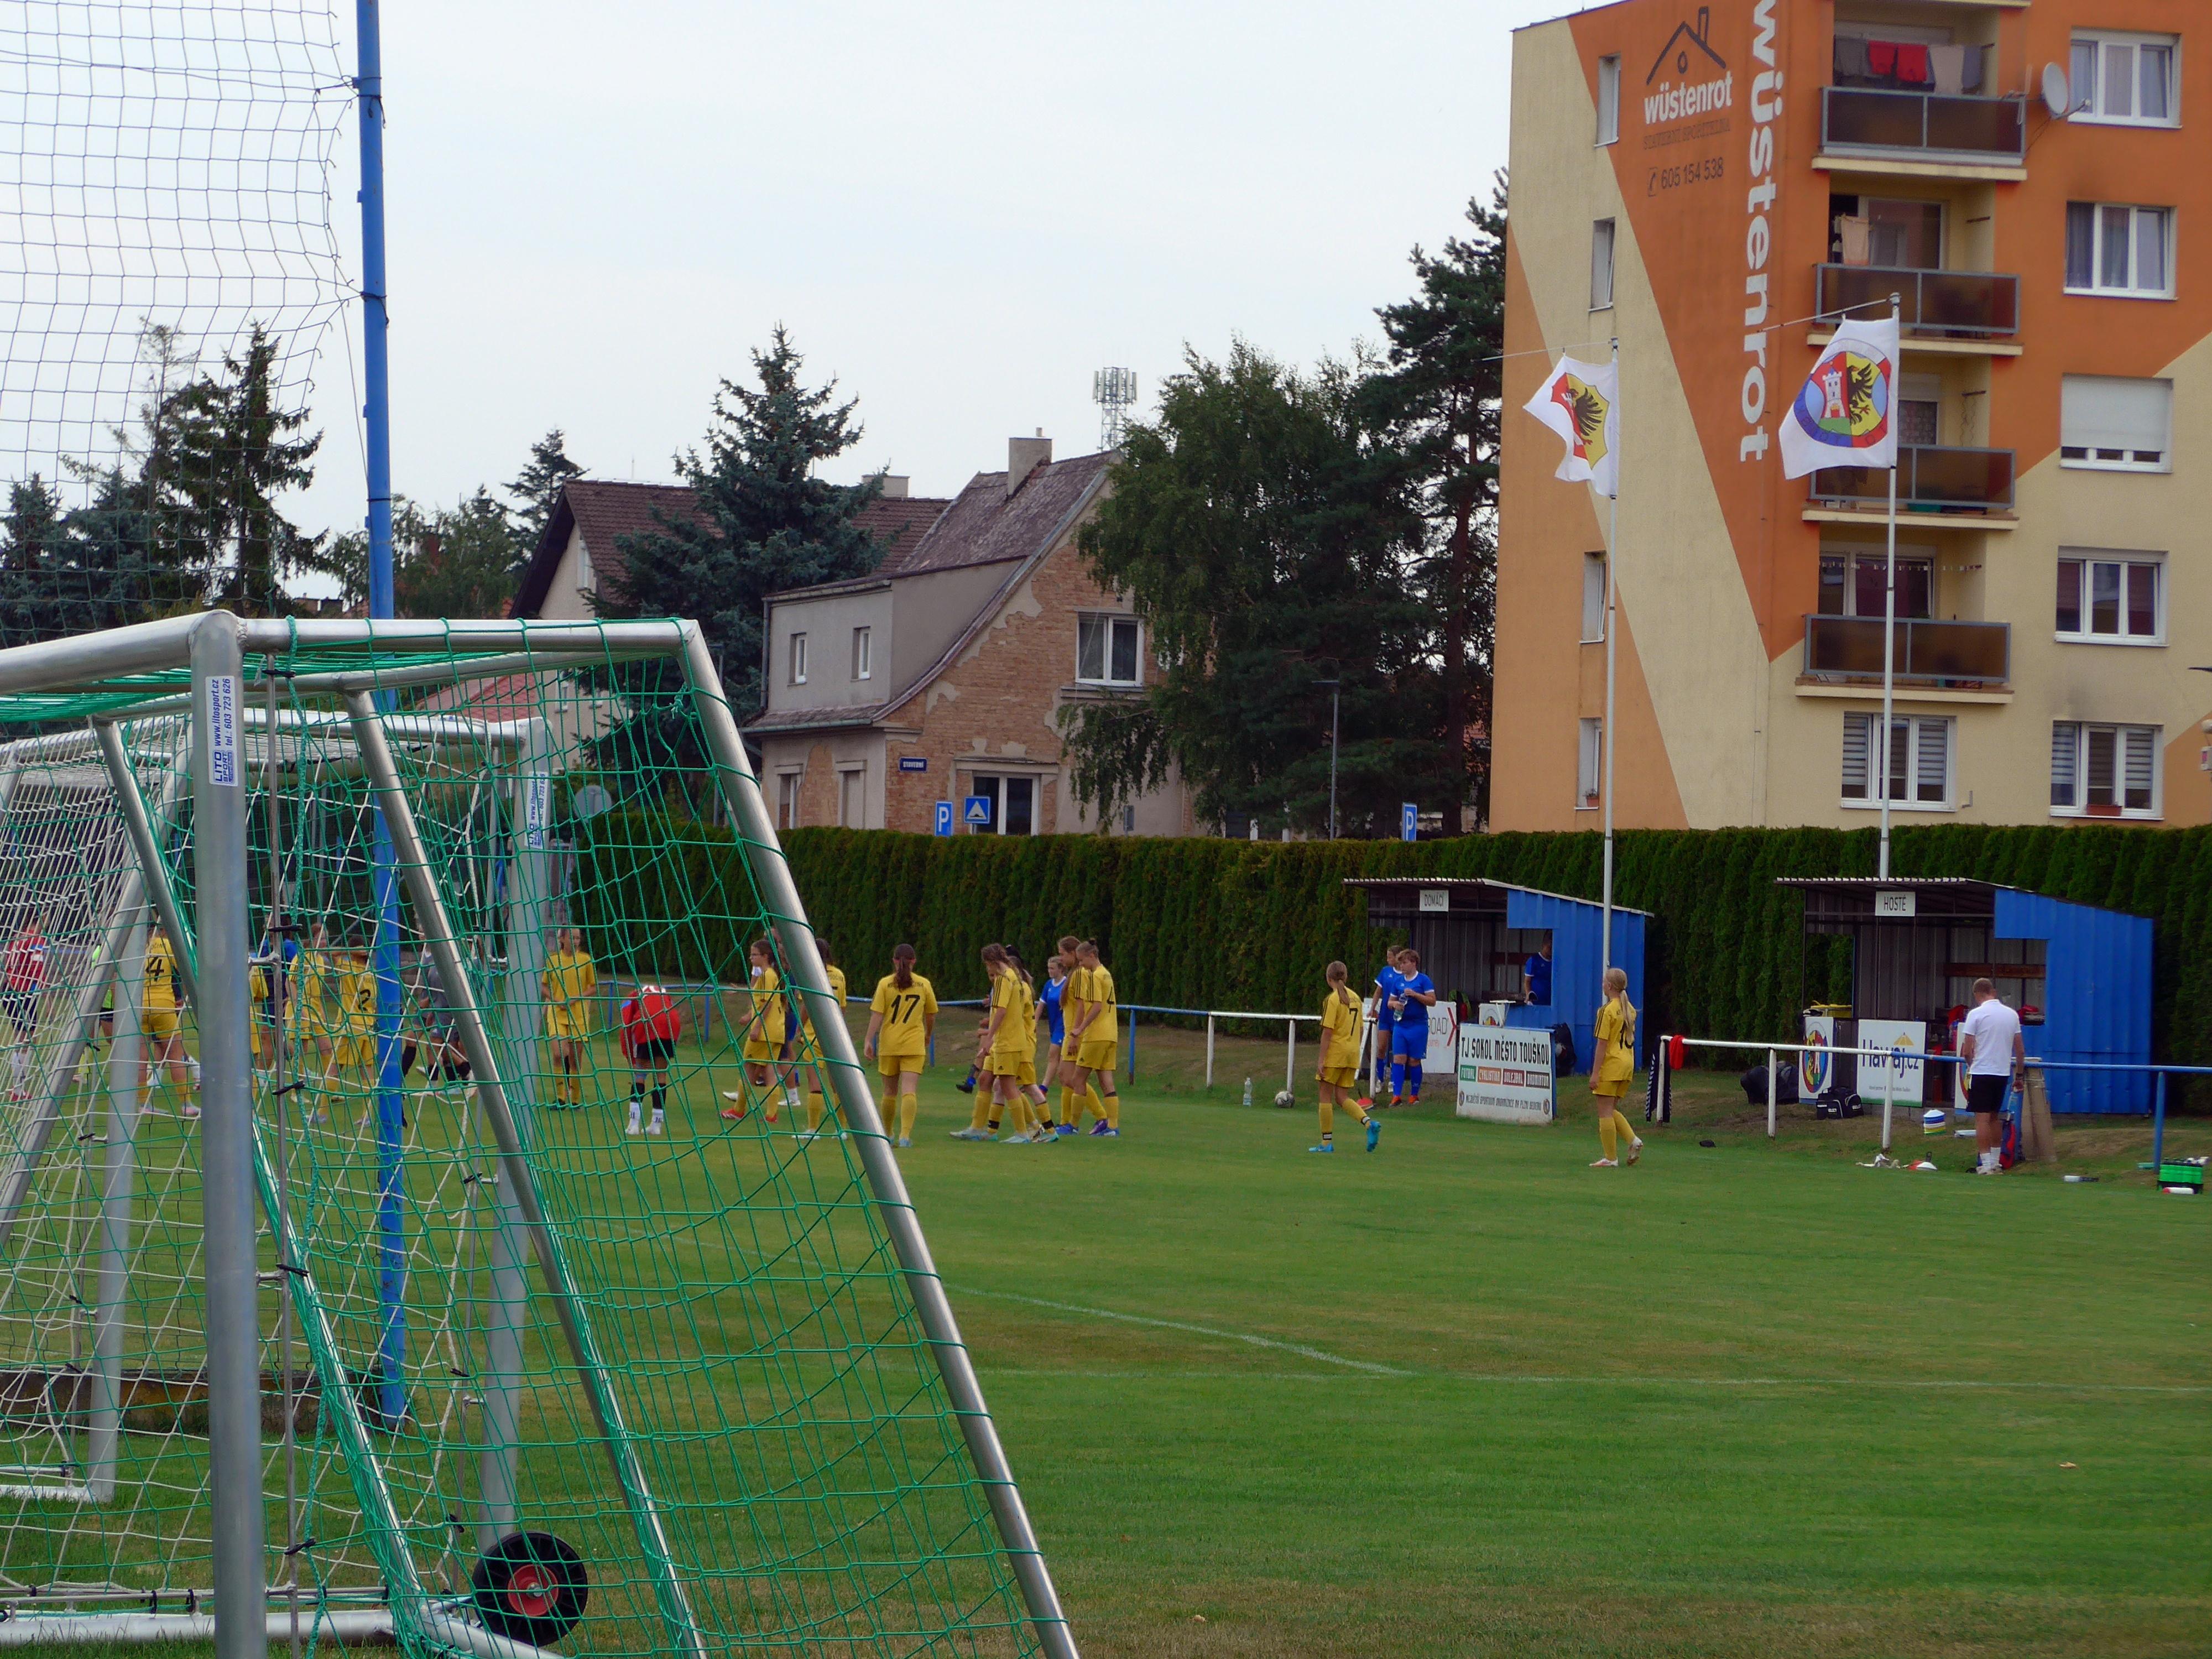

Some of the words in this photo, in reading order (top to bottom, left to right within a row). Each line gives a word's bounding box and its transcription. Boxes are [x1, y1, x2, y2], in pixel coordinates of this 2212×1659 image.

[1644, 71, 1733, 124] wüstenrot
[1661, 167, 1680, 189] 605
[1683, 163, 1700, 184] 154
[1704, 157, 1723, 180] 538
[1740, 0, 1783, 462] wüstenrot
[222, 679, 231, 695] 626
[211, 679, 222, 747] www.litosport.cz
[223, 696, 231, 711] 723
[214, 752, 222, 782] LITO
[939, 806, 949, 832] P
[1406, 811, 1413, 841] P
[1425, 892, 1444, 907] DOMÁCÍ
[1884, 894, 1906, 911] HOSTÉ
[145, 957, 164, 982] 4
[357, 989, 371, 1011] 2
[891, 994, 920, 1024] 17
[1107, 986, 1115, 1013] 4
[1349, 1008, 1358, 1036] 7
[1462, 1037, 1469, 1057] TJ
[1472, 1039, 1492, 1061] SOKOL
[1495, 1035, 1517, 1062] MĚSTO
